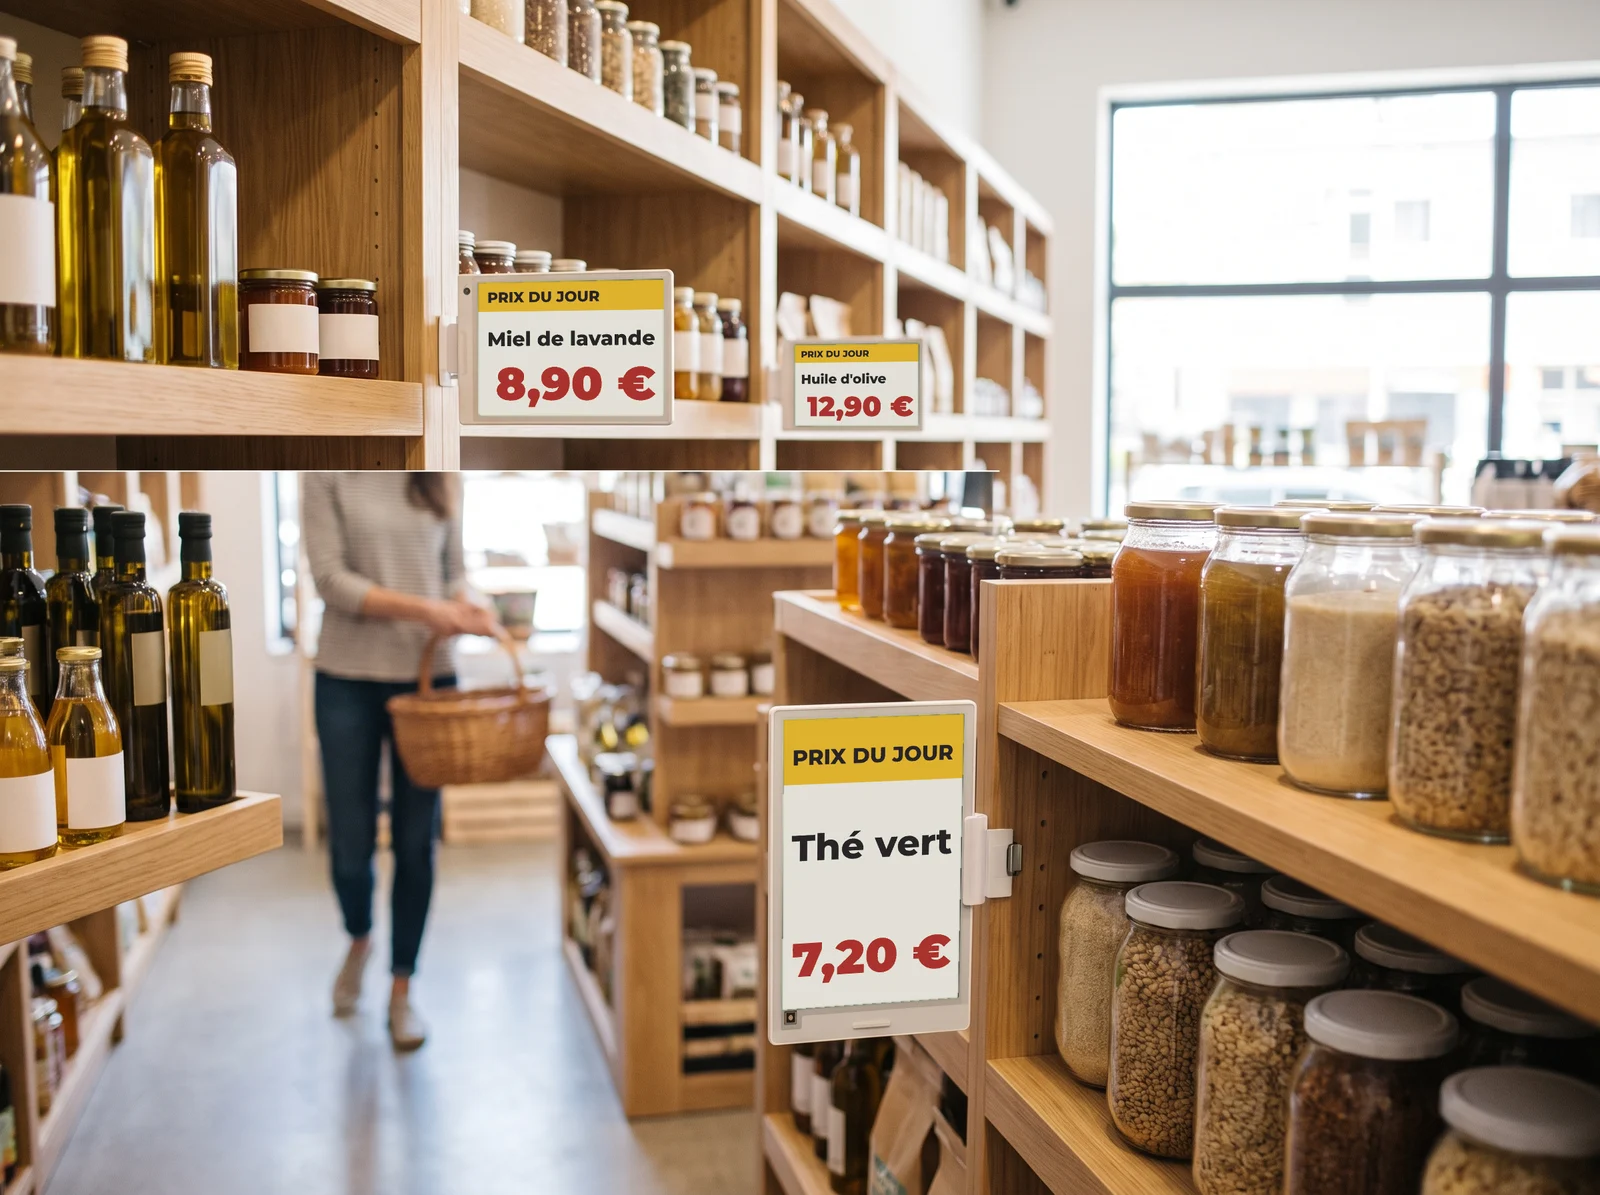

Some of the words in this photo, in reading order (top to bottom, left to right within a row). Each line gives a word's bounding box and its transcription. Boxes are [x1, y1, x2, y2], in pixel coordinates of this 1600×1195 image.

[487, 291, 524, 303] PRIX
[529, 291, 552, 303] DU
[556, 290, 600, 303] JOUR
[488, 329, 531, 347] Miel
[537, 330, 564, 347] de
[570, 329, 656, 347] lavande
[801, 350, 823, 358] PRIX
[825, 350, 840, 358] DU
[843, 350, 869, 358] JOUR
[496, 366, 603, 408] 8,90
[617, 365, 656, 401] €
[801, 372, 838, 385] Huile
[840, 372, 887, 385] d'olive
[806, 395, 881, 422] 12,90
[890, 395, 914, 417] €
[793, 748, 846, 766] PRIX
[853, 747, 886, 764] DU
[892, 744, 953, 763] JOUR
[791, 830, 864, 862] Thé
[874, 829, 952, 858] vert
[792, 937, 897, 984] 7,20
[912, 933, 951, 970] €
